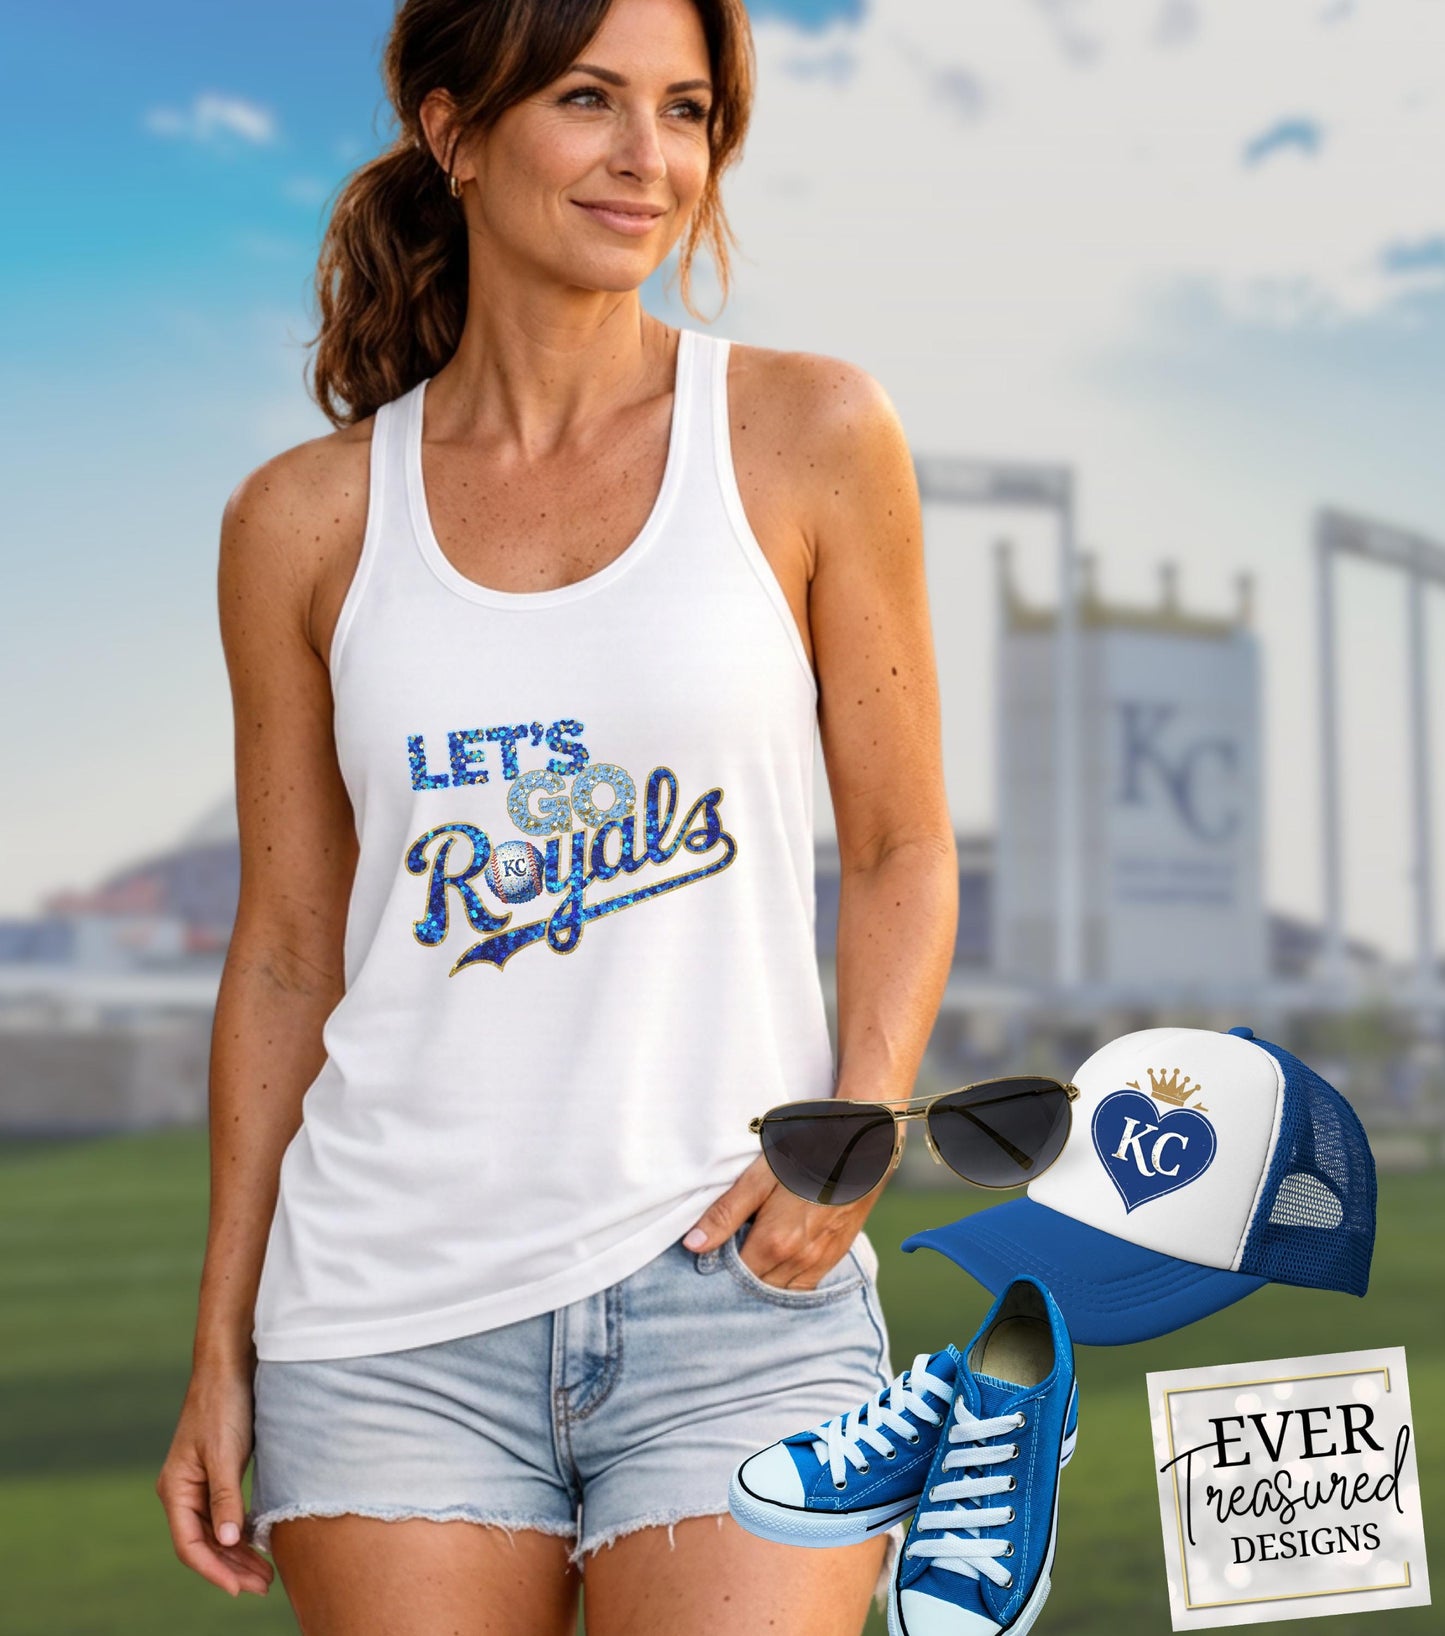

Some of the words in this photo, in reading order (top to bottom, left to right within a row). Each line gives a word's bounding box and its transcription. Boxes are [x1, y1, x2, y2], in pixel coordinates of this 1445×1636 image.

[407, 719, 589, 791] LET'S
[1116, 699, 1239, 844] KC
[507, 763, 636, 836] GO
[504, 858, 527, 877] KC
[1111, 1116, 1188, 1177] KC
